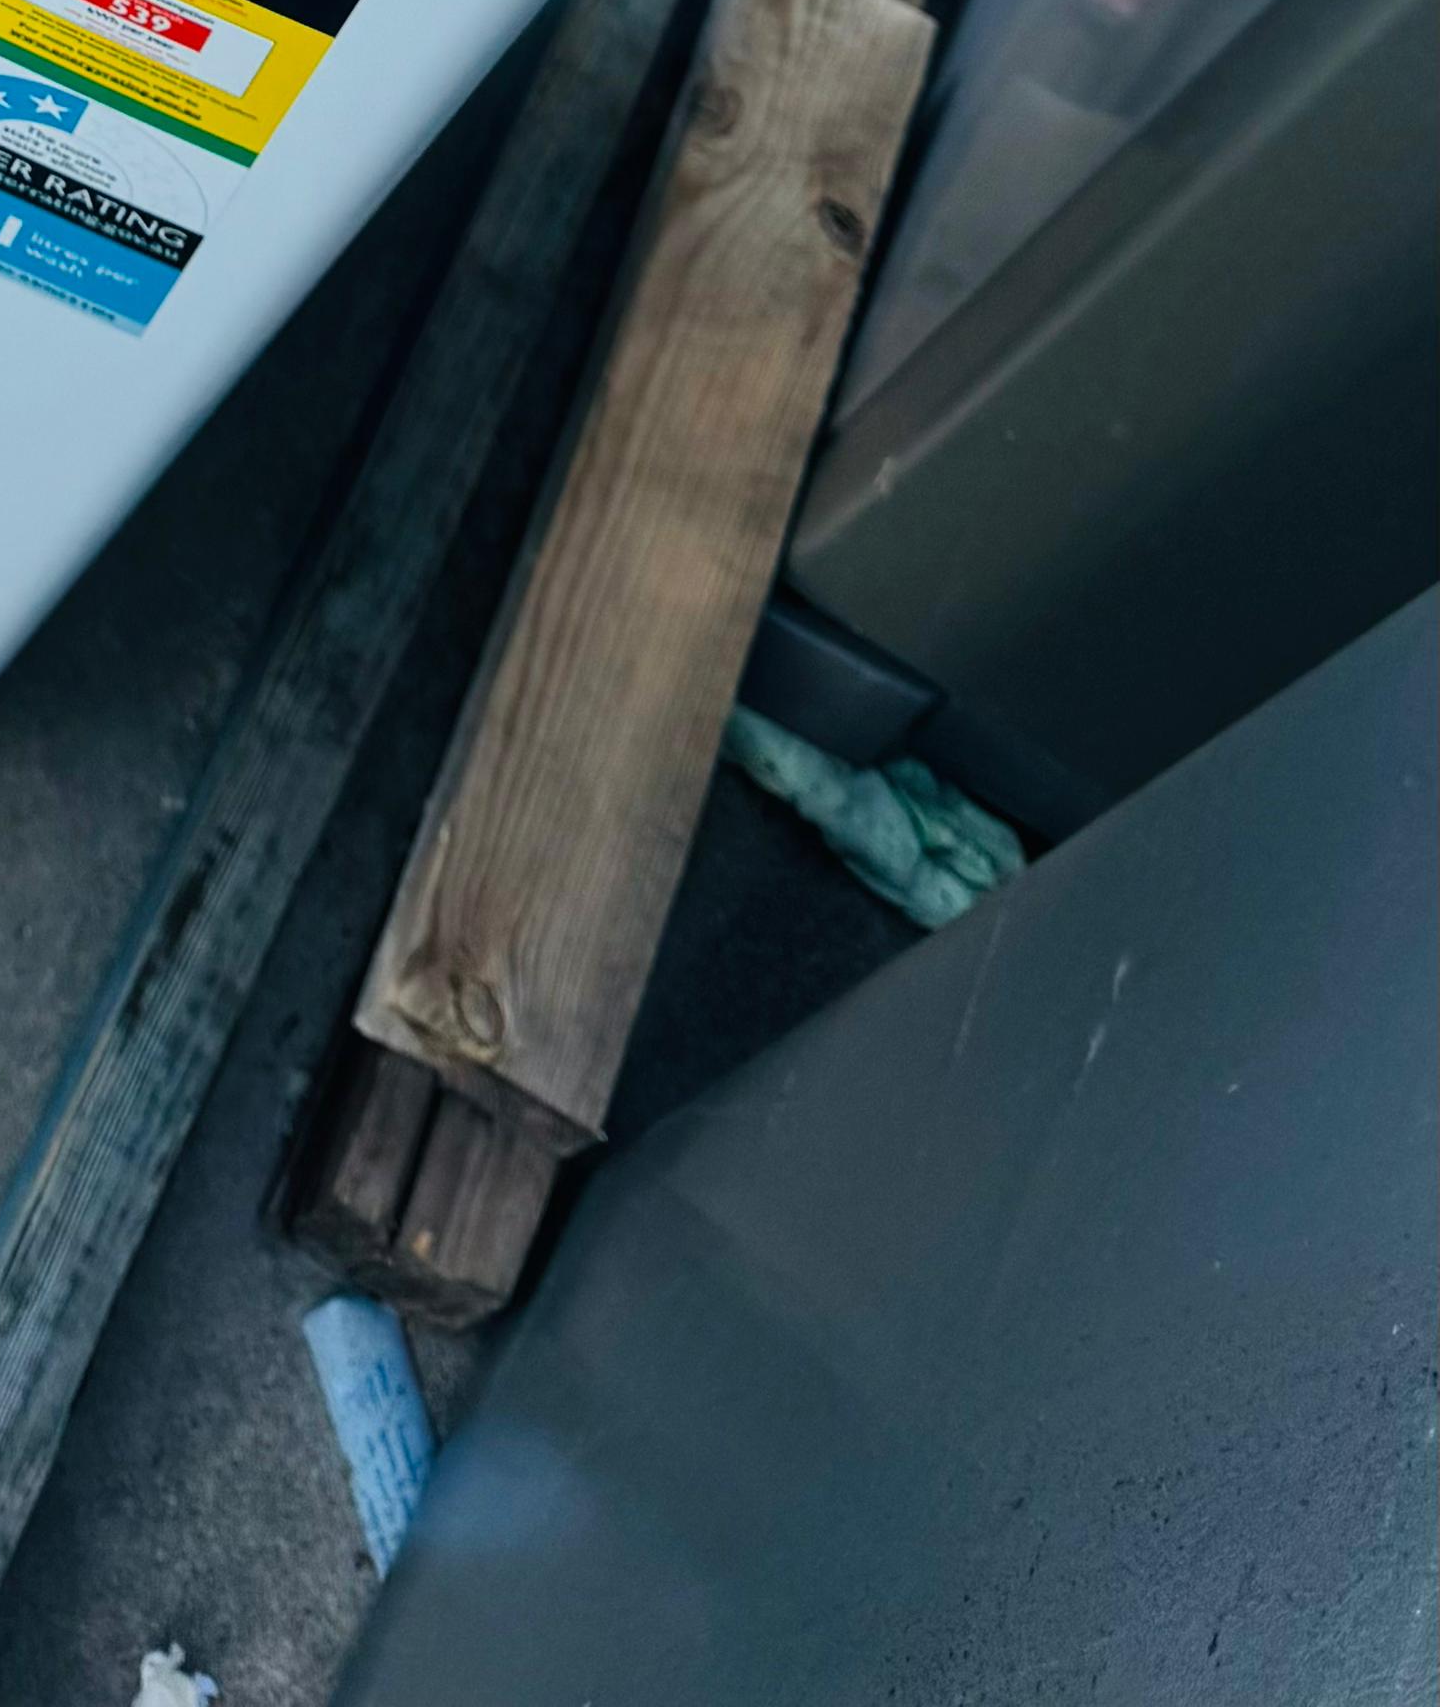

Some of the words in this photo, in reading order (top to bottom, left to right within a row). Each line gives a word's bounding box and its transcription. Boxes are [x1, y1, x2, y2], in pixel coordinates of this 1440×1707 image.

[17, 21, 40, 35] For
[41, 33, 75, 52] more
[85, 5, 121, 26] kWh
[120, 23, 143, 38] per
[8, 28, 203, 122] www.energyrating.gov.au
[0, 133, 45, 159] water
[2, 124, 41, 147] stars
[43, 143, 73, 162] the
[73, 158, 118, 183] more
[26, 125, 58, 145] The
[57, 141, 102, 166] more
[47, 175, 189, 249] RATING
[22, 242, 85, 279] wash
[28, 230, 92, 268] litres
[94, 261, 139, 290] per
